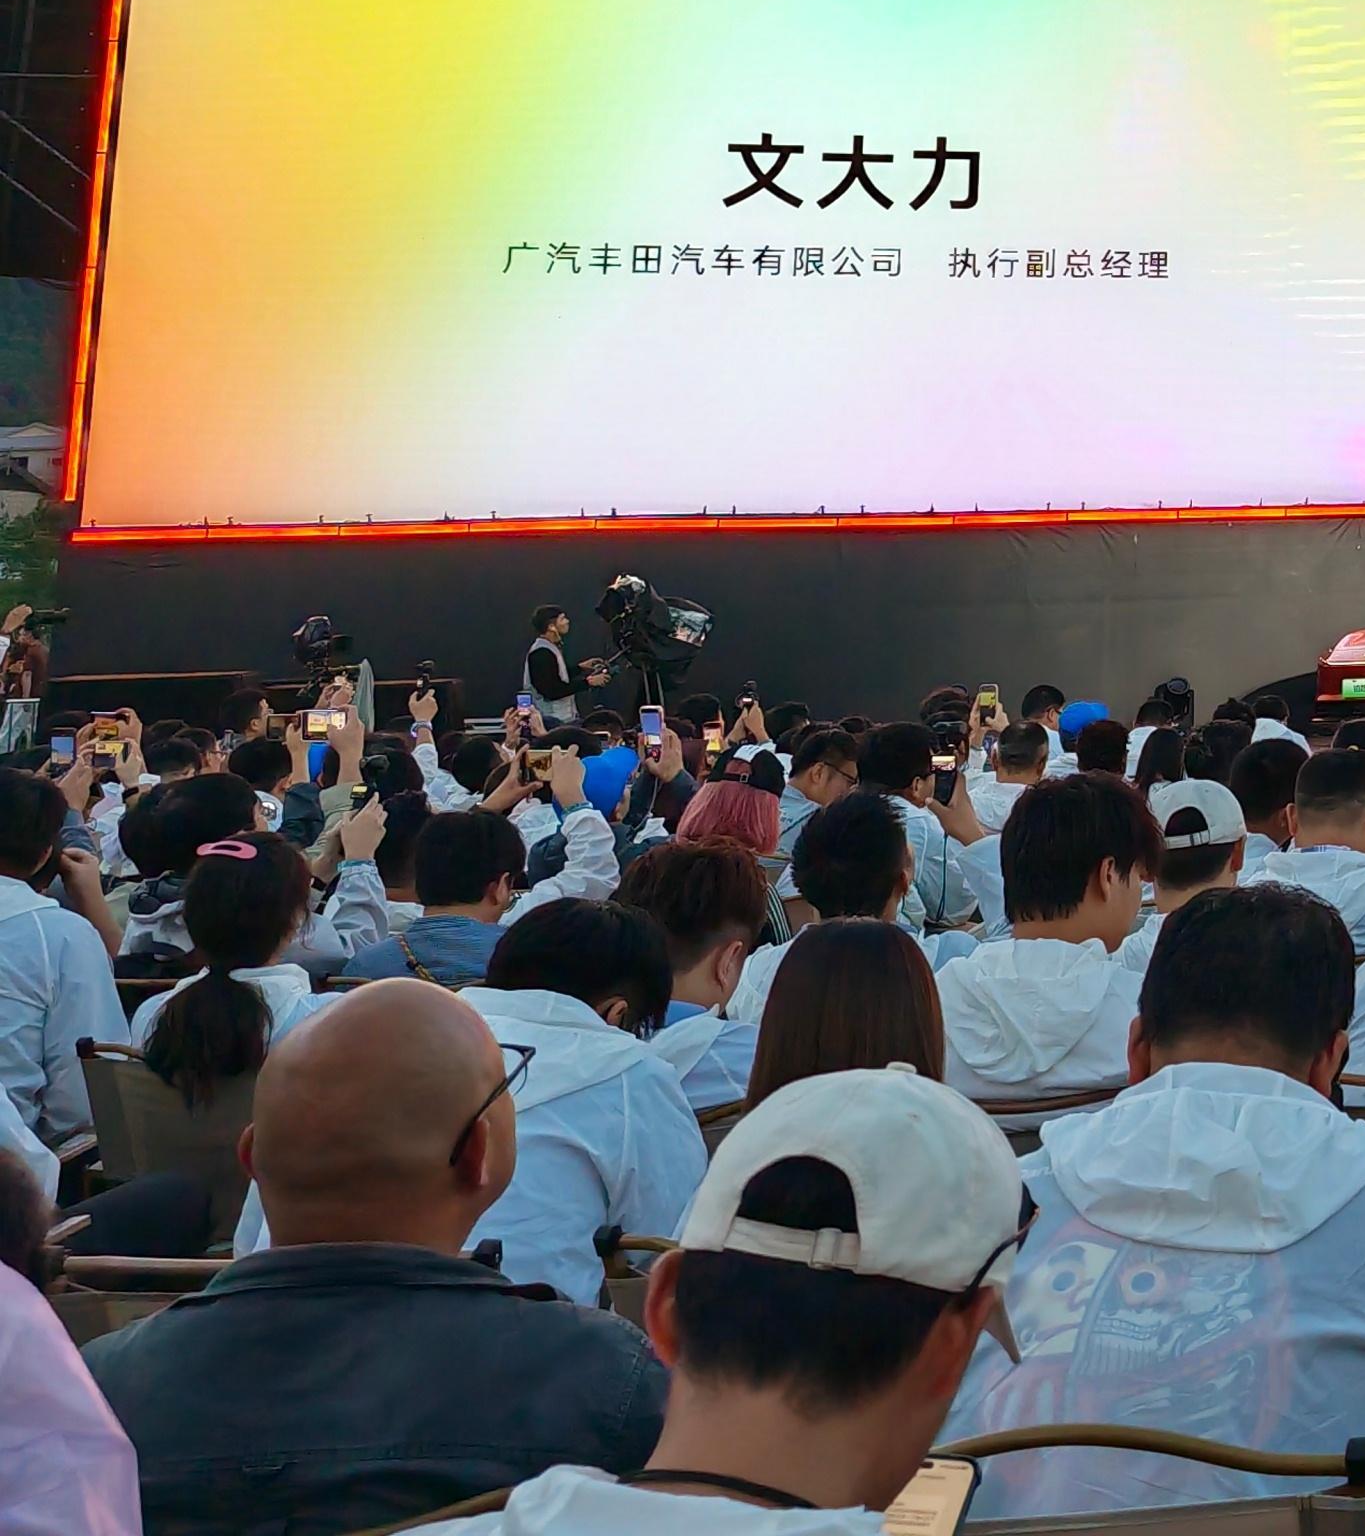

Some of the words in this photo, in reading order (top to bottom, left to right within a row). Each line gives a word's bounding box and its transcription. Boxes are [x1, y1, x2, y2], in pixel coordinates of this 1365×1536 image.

[723, 132, 981, 211] 文大力
[501, 241, 903, 278] 广汽丰田汽车有限公司
[947, 247, 1171, 279] 执行副总经理
